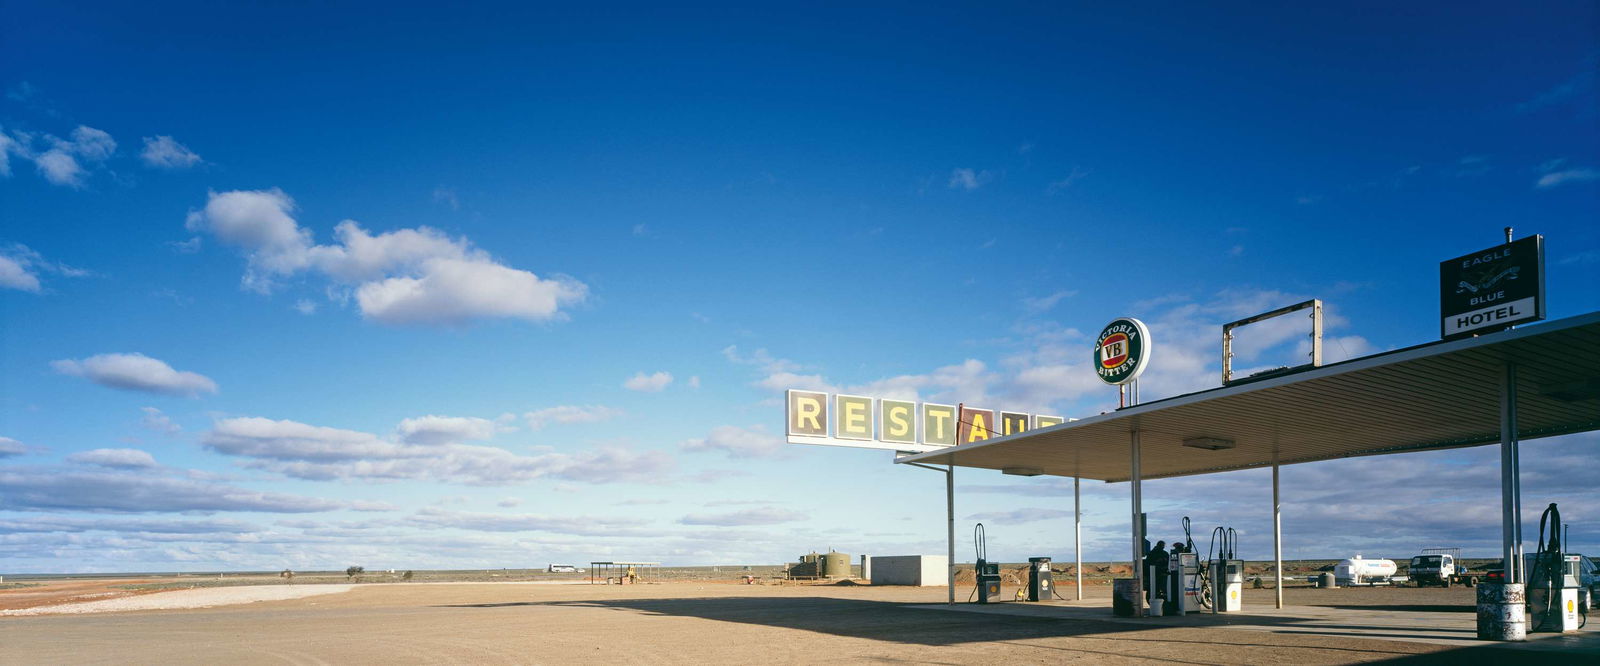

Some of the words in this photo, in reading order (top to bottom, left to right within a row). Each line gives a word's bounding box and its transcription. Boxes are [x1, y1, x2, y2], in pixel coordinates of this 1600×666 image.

[1463, 248, 1511, 268] EAGLE
[1470, 290, 1505, 306] BLUE
[1457, 306, 1520, 328] HOTEL
[1095, 324, 1137, 352] VICTORIA
[1105, 343, 1121, 358] VB
[1098, 357, 1136, 377] BITTER
[797, 397, 1056, 442] RESTAU
